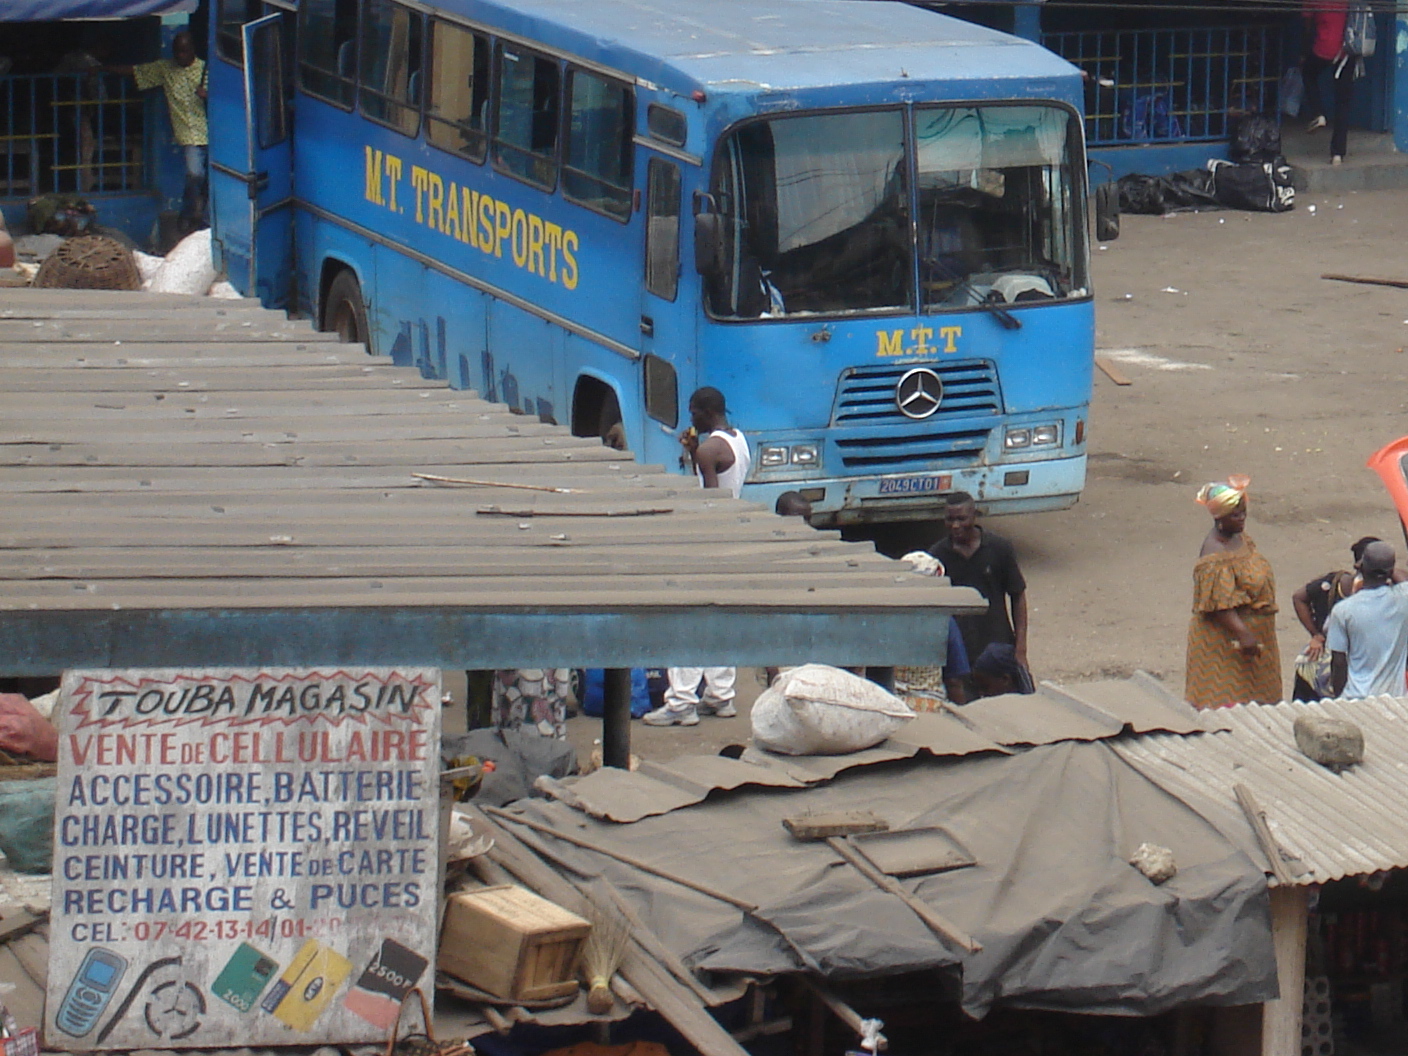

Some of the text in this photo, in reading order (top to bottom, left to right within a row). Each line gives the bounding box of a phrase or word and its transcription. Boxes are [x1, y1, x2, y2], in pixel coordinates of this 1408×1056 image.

[365, 145, 579, 290] M.T. TRANSPORTS
[876, 326, 963, 357] M.T.T
[880, 477, 939, 493] 2049CT01
[99, 681, 421, 716] TOUBA MAGASIN
[69, 729, 428, 766] VENTE DE CELLULAIRE
[225, 851, 303, 878] VENTE
[309, 859, 333, 876] DE
[338, 849, 427, 876] CARTE
[64, 882, 421, 915] RECHARGE & PUCES
[71, 922, 128, 943] CEL:
